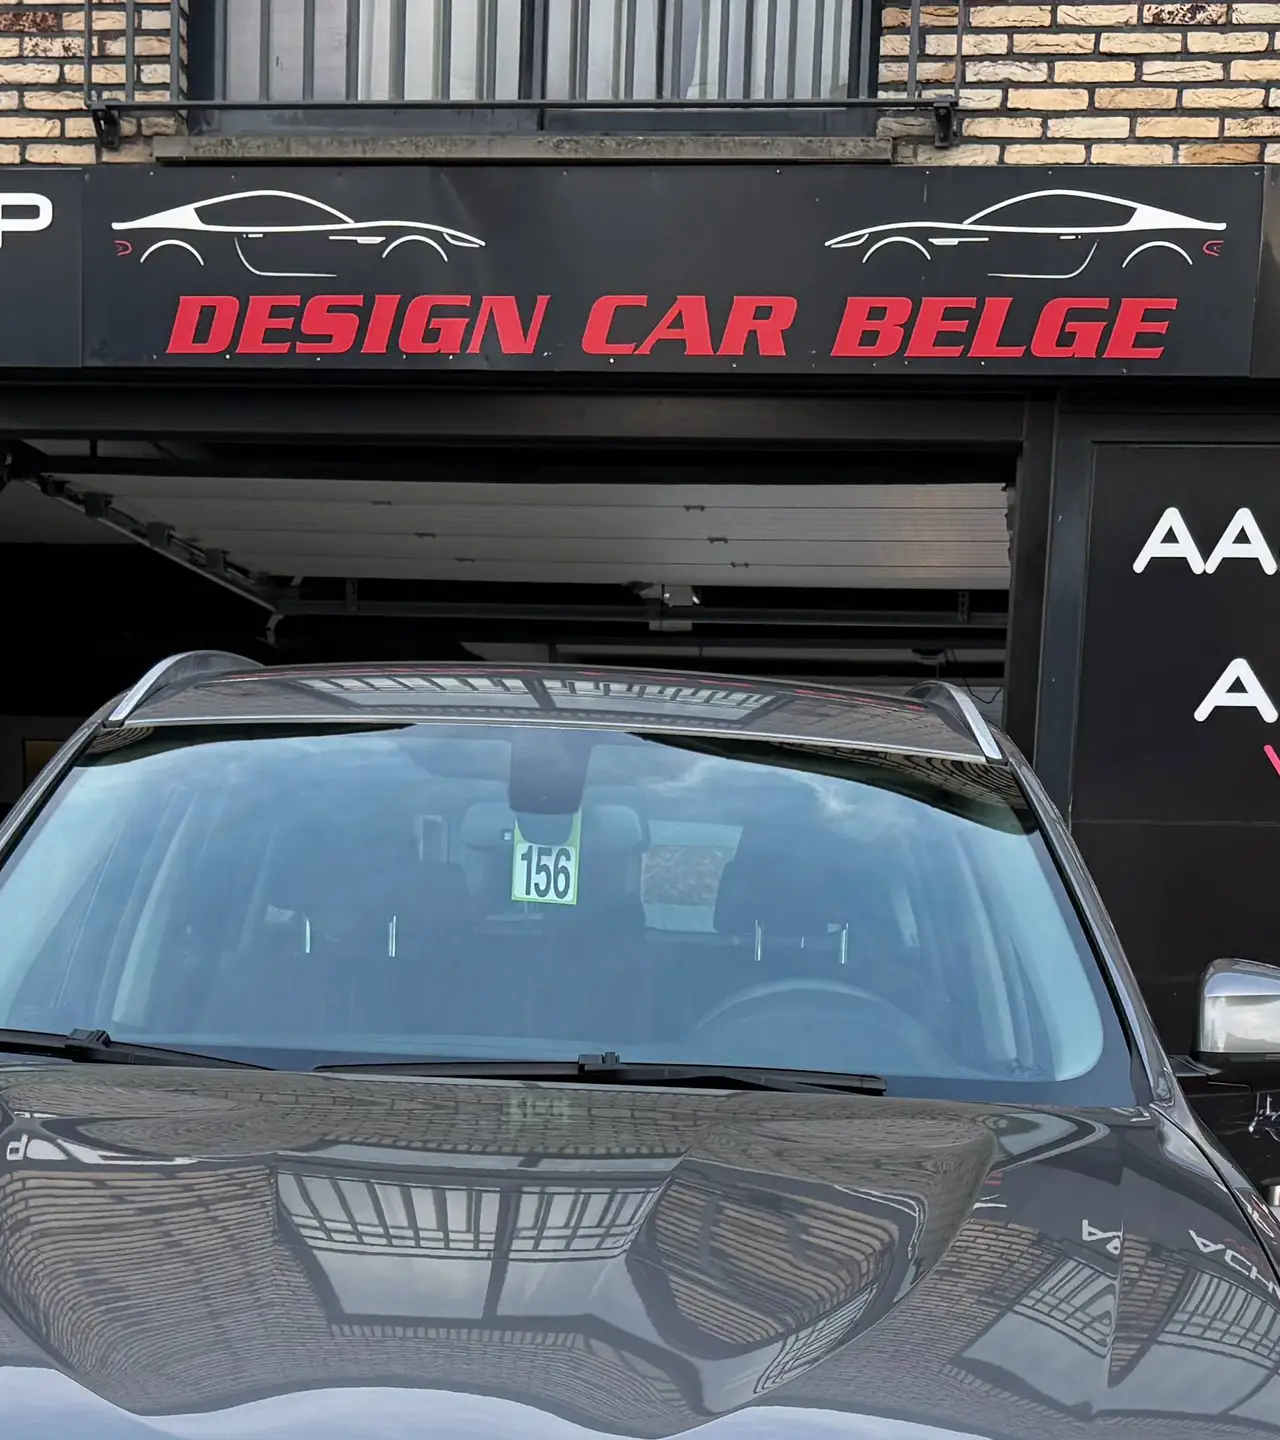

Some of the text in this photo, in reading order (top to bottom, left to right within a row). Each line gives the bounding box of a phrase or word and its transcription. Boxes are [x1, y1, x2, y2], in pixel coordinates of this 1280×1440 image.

[166, 293, 1179, 360] DESIGN CAR BELGE
[520, 844, 572, 900] 156
